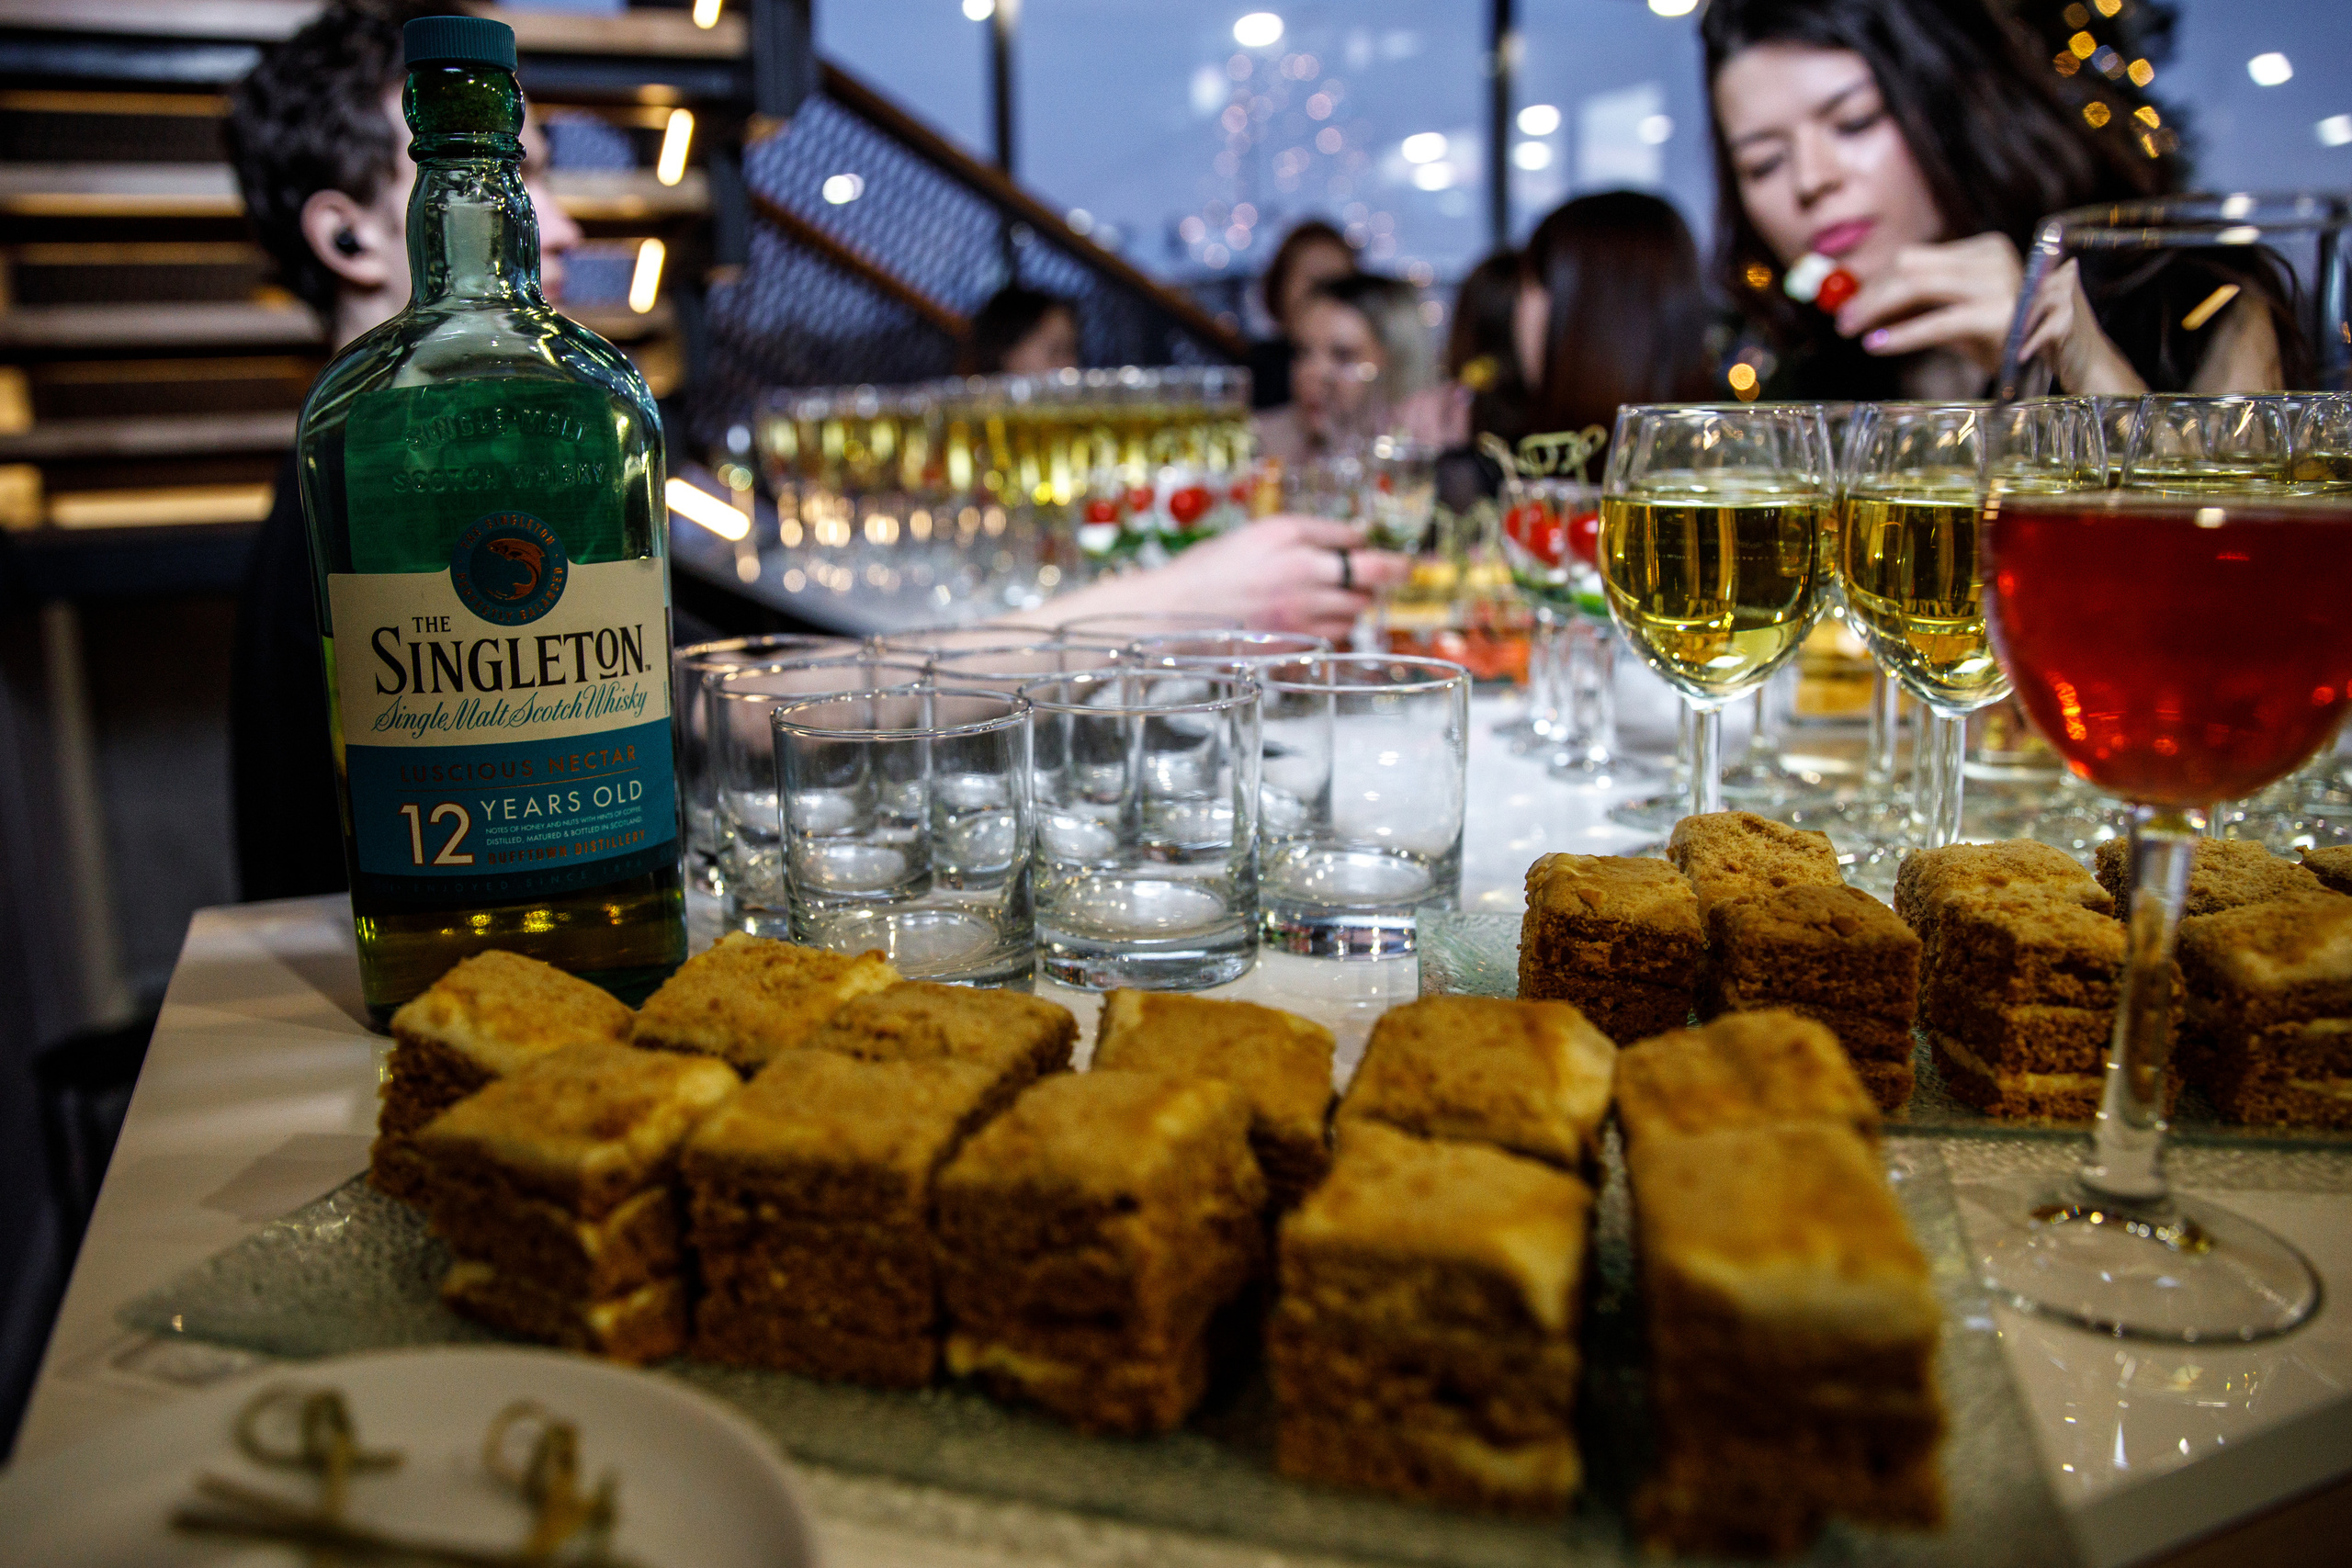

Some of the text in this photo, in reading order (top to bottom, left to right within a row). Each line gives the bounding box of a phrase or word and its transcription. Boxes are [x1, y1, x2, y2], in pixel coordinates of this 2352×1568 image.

[460, 514, 556, 549] THE SINGLETON
[456, 567, 563, 622] PERFECTLY BALANCED
[413, 615, 451, 634] THE
[370, 624, 644, 696] SINGLETON
[370, 694, 449, 740] Single
[444, 695, 509, 732] Malt
[503, 691, 583, 728] Scotch
[582, 680, 648, 719] Whisky
[400, 744, 637, 783] LUSCIOUS NECTAR
[480, 780, 643, 821] YEARS OLD
[397, 800, 476, 867] 12
[485, 826, 510, 835] NOTES
[521, 822, 545, 831] HONEY
[546, 820, 562, 829] AND
[562, 818, 580, 827] NUTS
[580, 815, 596, 824] WITH
[486, 836, 525, 846] DISTILLED,
[526, 830, 562, 842] MATURED
[571, 826, 599, 837] BOTTLED
[488, 845, 568, 865] DUFFTOWN
[574, 829, 646, 856] DISTILLERY
[413, 880, 509, 894] ENJOYED
[526, 871, 587, 889] SINCE
